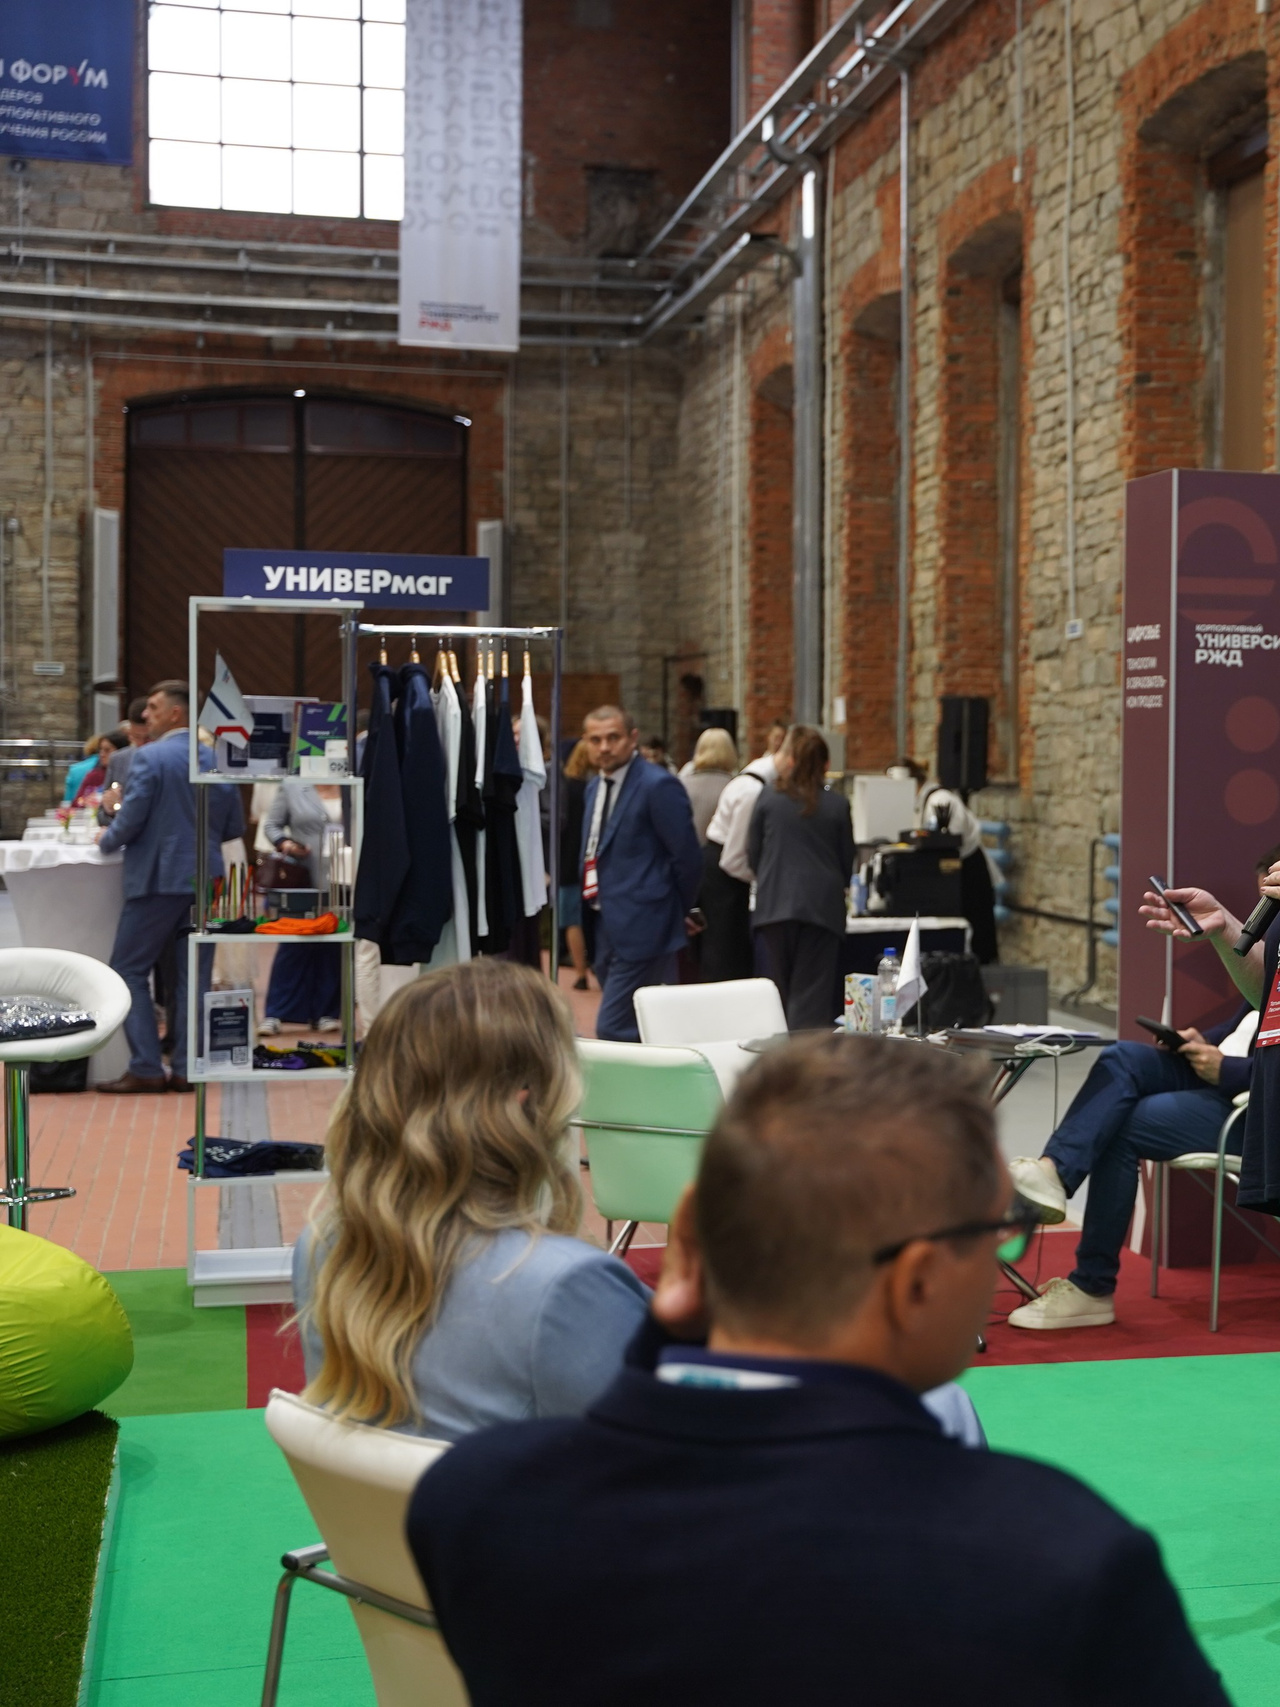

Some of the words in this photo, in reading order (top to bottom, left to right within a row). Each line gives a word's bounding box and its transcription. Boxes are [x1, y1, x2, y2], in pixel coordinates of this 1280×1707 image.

[263, 566, 453, 595] УНИВЕРмаг
[1195, 624, 1263, 633] КОРПОРАТИВНЫЙ
[1195, 649, 1243, 667] РЖД
